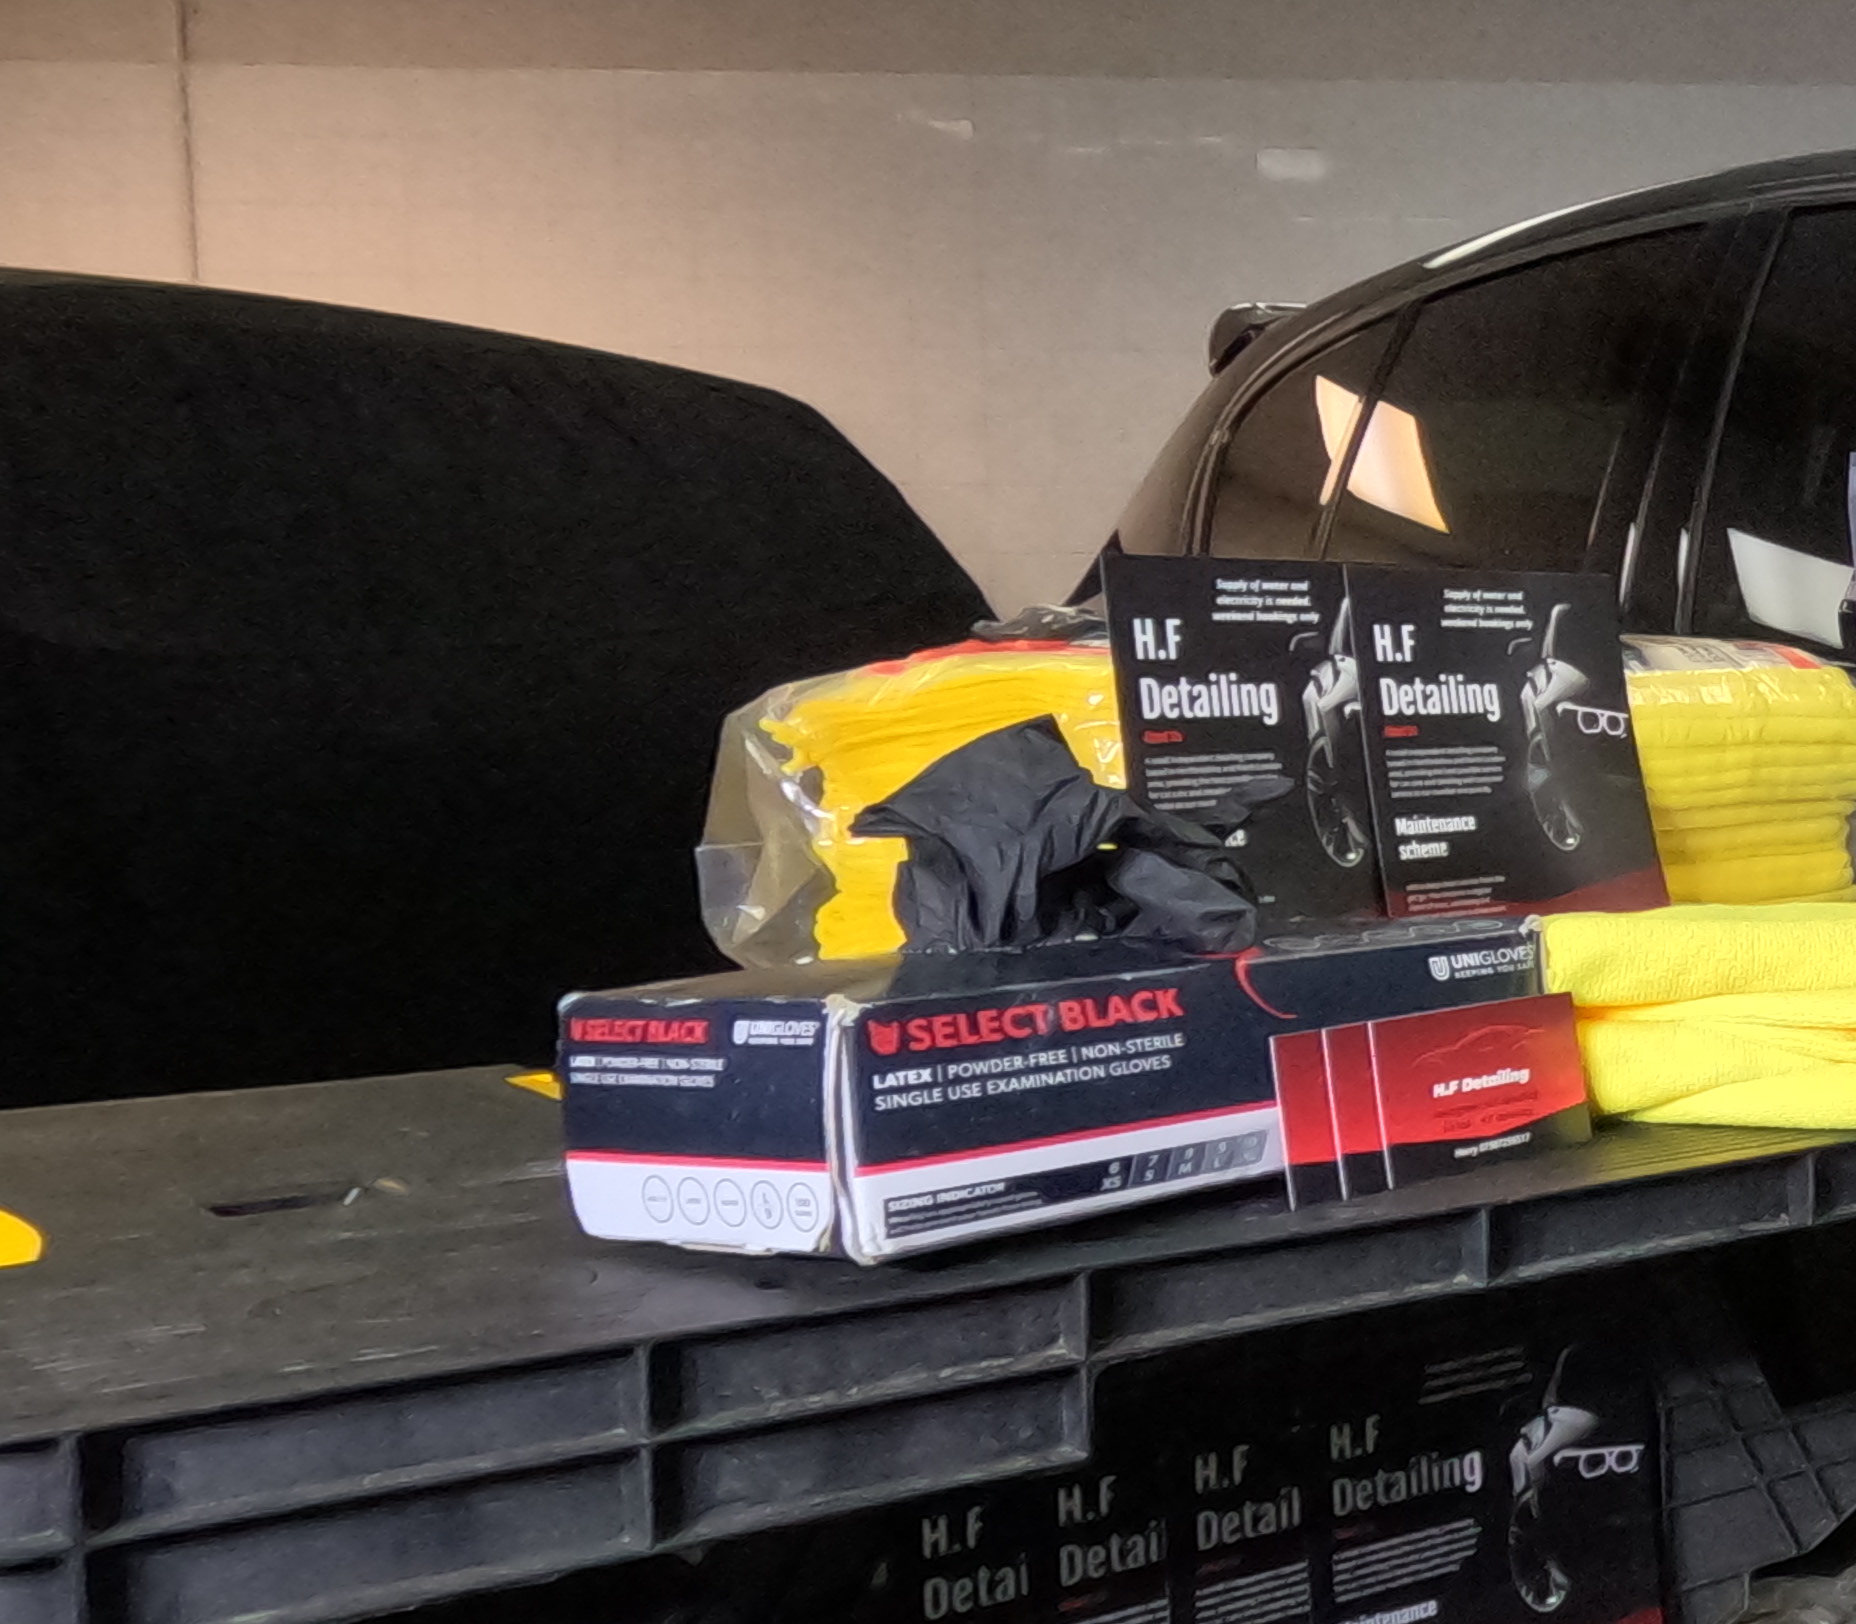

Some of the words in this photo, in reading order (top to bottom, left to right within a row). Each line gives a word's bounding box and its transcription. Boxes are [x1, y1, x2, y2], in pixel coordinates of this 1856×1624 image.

[1132, 618, 1184, 661] H.F
[1373, 623, 1417, 663] H.F
[1138, 670, 1280, 727] Detailing
[1378, 673, 1502, 723] Detailing
[1394, 812, 1478, 837] Maintenance
[1398, 838, 1450, 861] scheme
[584, 1018, 646, 1043] SELECT
[647, 1020, 710, 1044] BLACK
[907, 1004, 1051, 1052] SELECT
[1057, 988, 1185, 1032] BLACK
[872, 1067, 933, 1090] LATEX
[947, 1049, 1069, 1080] POWDER-FREE
[1080, 1032, 1185, 1062] NON-STERILE
[874, 1088, 943, 1112] SINGLE
[947, 1083, 982, 1101] USE
[986, 1064, 1106, 1095] EXAMINATION
[1108, 1055, 1172, 1077] GLOVES
[1329, 1413, 1381, 1460] H.F
[1194, 1443, 1250, 1494] H.F
[1331, 1449, 1484, 1518] Detailing
[1057, 1475, 1118, 1527] H.F
[921, 1505, 984, 1560] H.F
